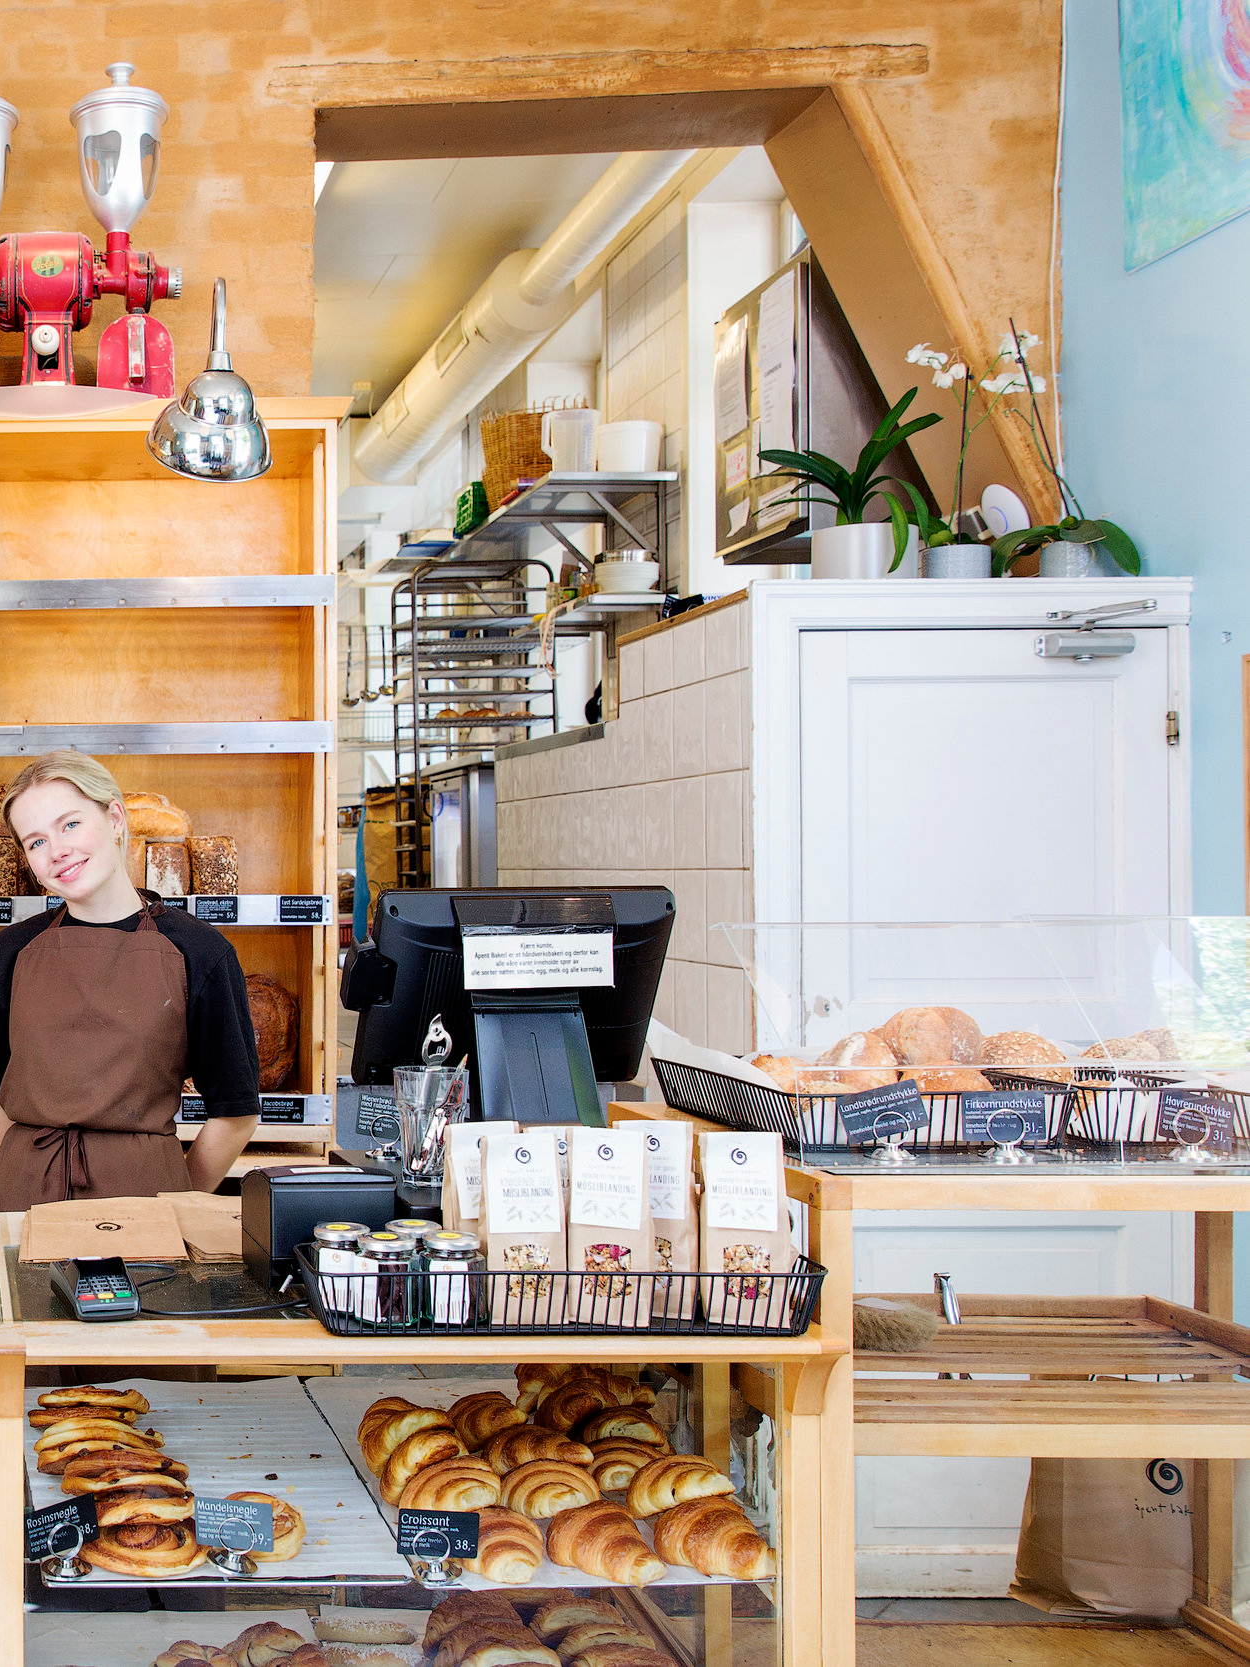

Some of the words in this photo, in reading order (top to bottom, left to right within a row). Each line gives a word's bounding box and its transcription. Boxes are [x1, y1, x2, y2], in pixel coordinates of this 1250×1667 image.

[840, 1087, 918, 1113] Landbrødrundstykke
[965, 1100, 1042, 1109] Firkornrundstykke
[197, 1500, 258, 1516] Mandelsnegle
[27, 1505, 78, 1529] Rosinsnegle
[401, 1513, 450, 1527] Croissant
[454, 1539, 475, 1551] 38,-
